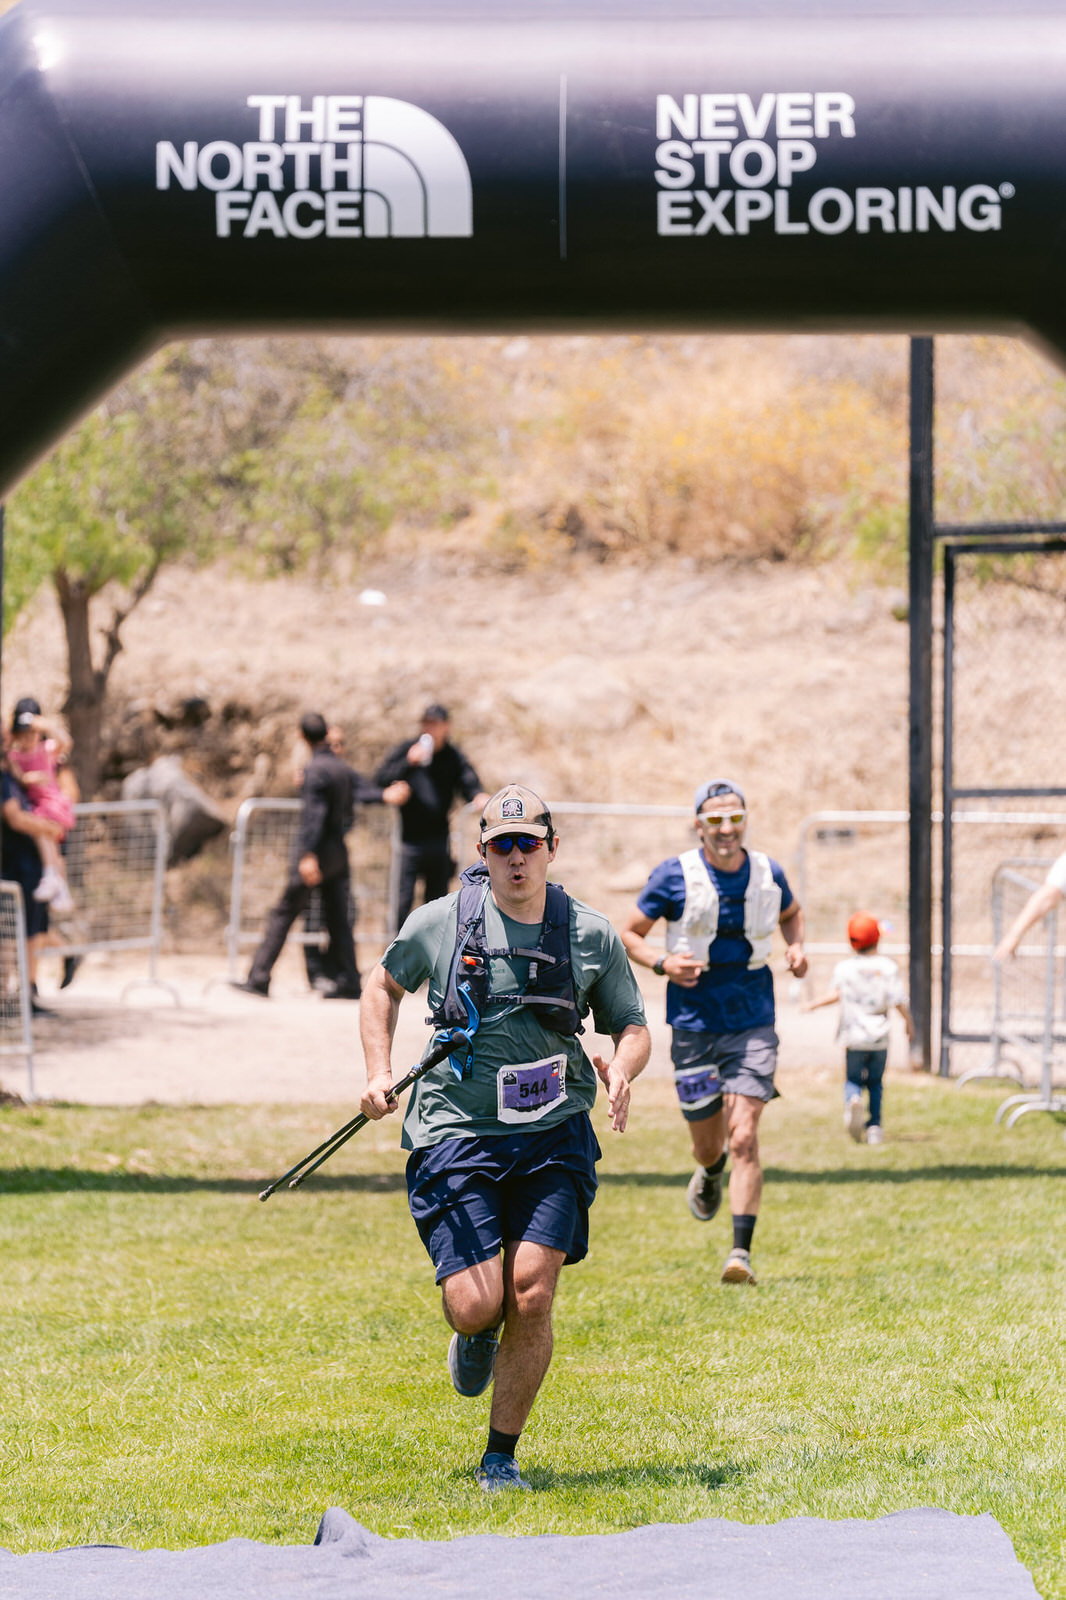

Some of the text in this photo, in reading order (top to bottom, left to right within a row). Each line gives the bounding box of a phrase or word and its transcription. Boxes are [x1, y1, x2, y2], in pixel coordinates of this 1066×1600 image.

[247, 95, 362, 142] THE
[656, 92, 856, 140] NEVER
[156, 141, 362, 190] NORTH
[654, 139, 817, 189] STOP
[216, 191, 362, 238] FACE
[520, 1078, 548, 1098] 544
